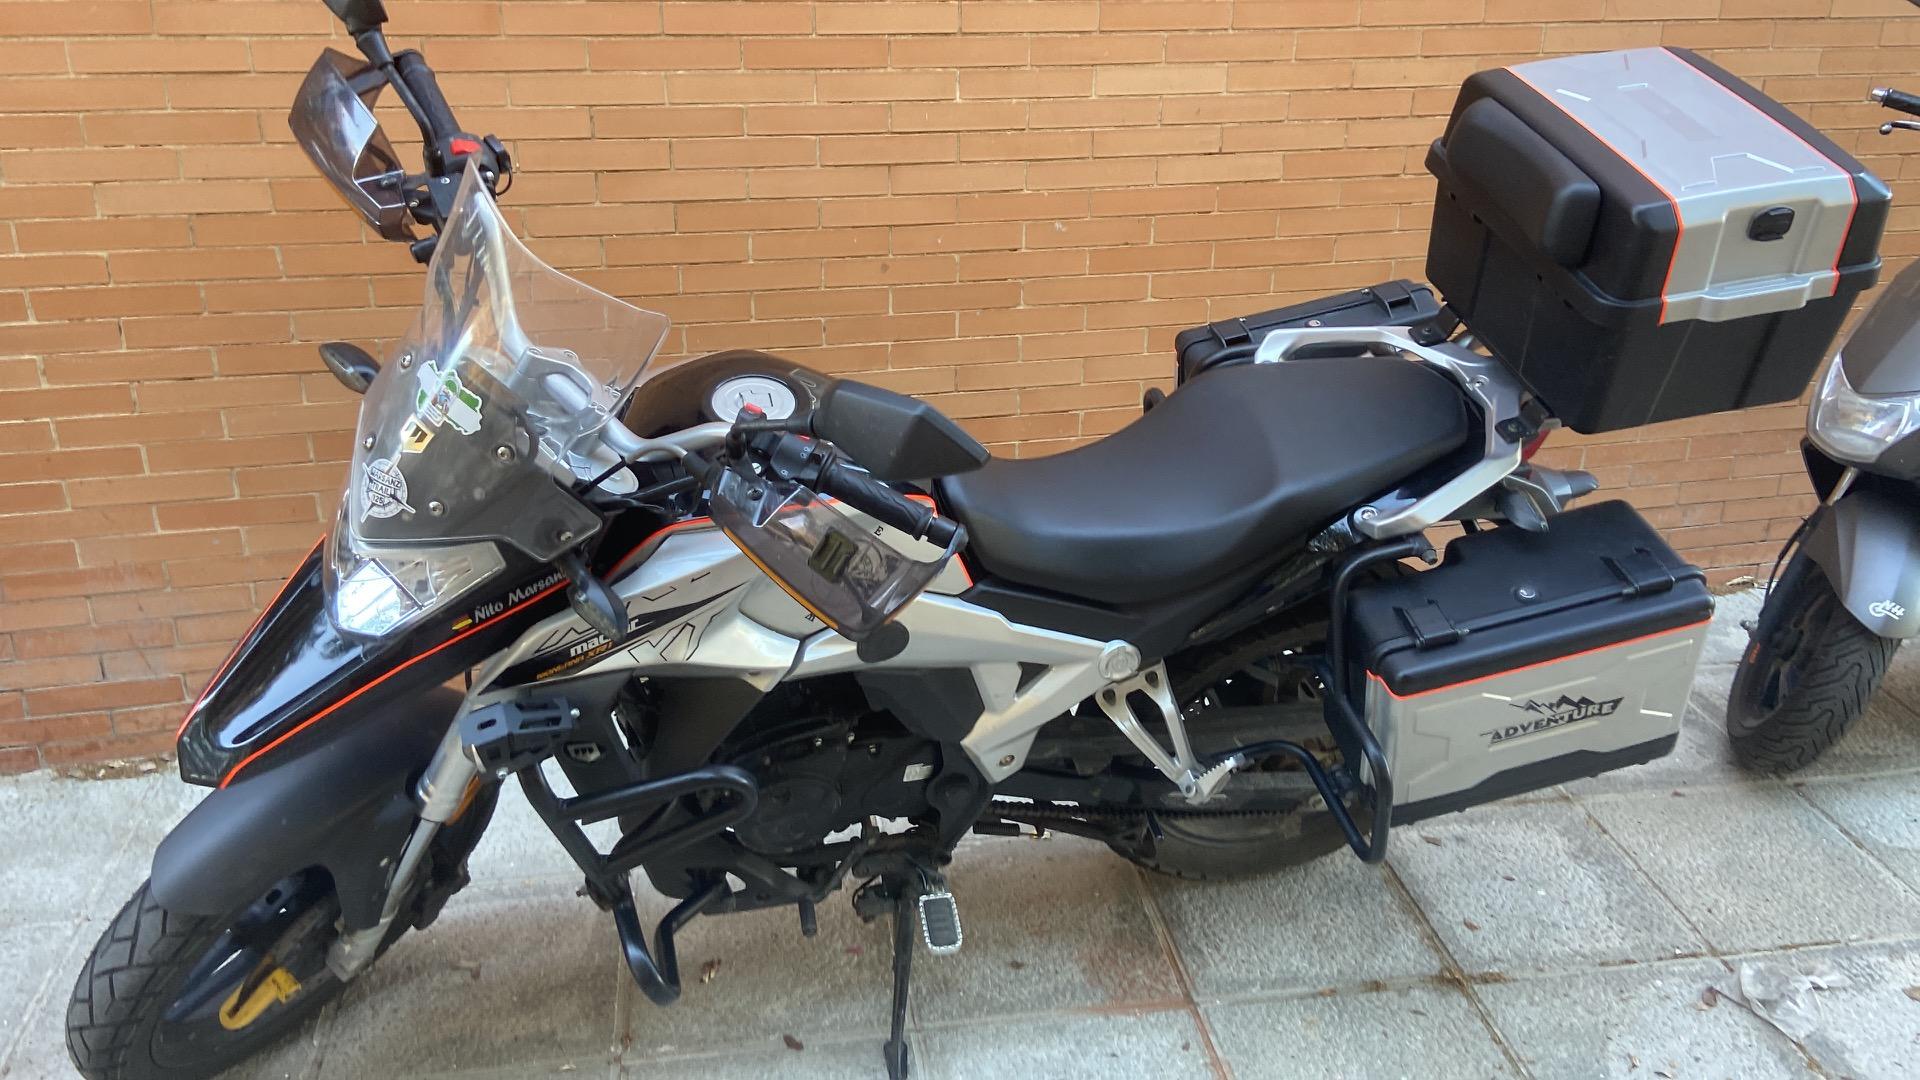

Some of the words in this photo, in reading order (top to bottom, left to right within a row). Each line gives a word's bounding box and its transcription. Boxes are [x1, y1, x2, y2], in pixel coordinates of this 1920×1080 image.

[372, 493, 385, 504] 125
[874, 525, 884, 536] E
[1490, 702, 1616, 742] ADVENTURE
